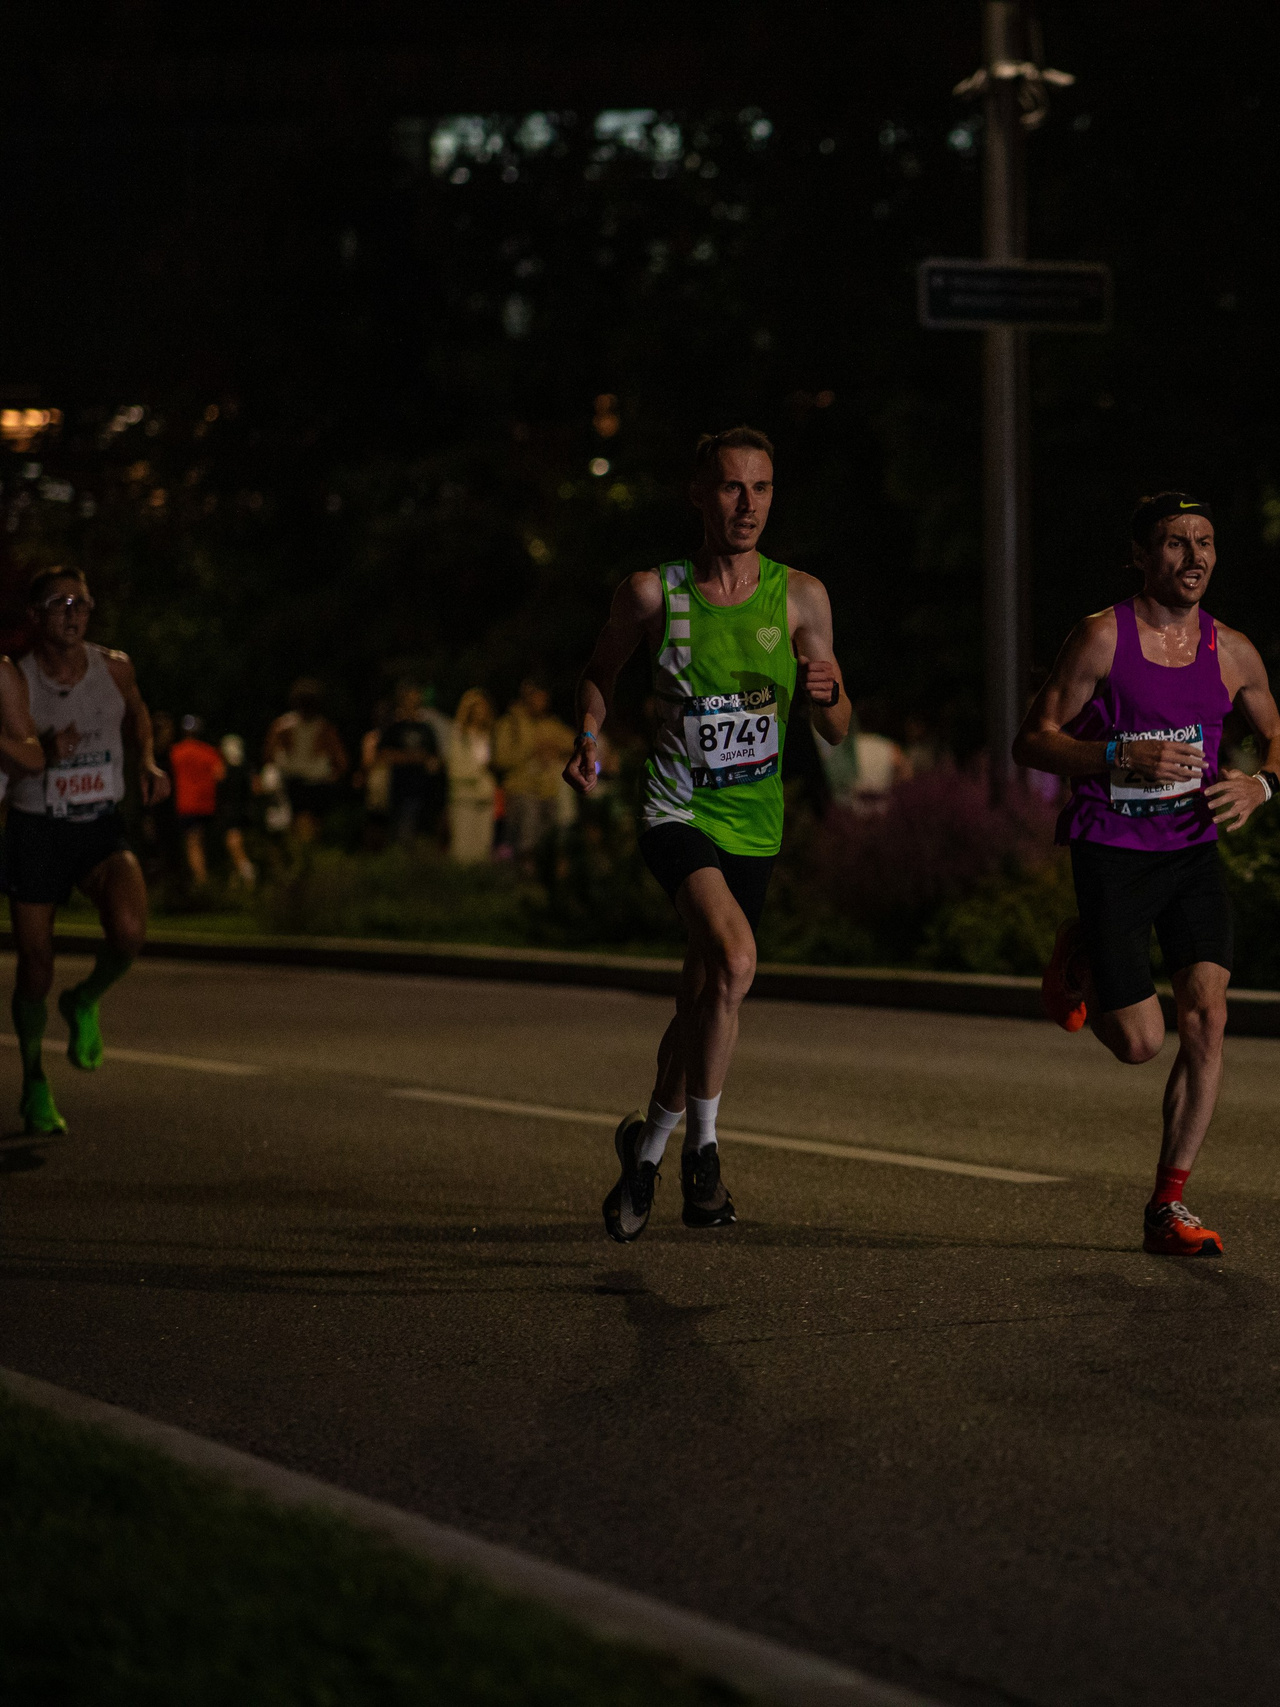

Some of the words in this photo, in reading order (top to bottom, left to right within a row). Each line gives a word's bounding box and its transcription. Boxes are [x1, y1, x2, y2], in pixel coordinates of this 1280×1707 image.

[699, 716, 770, 752] 8749
[720, 749, 755, 761] ЭДУАРД
[1143, 784, 1176, 793] ALEXEY
